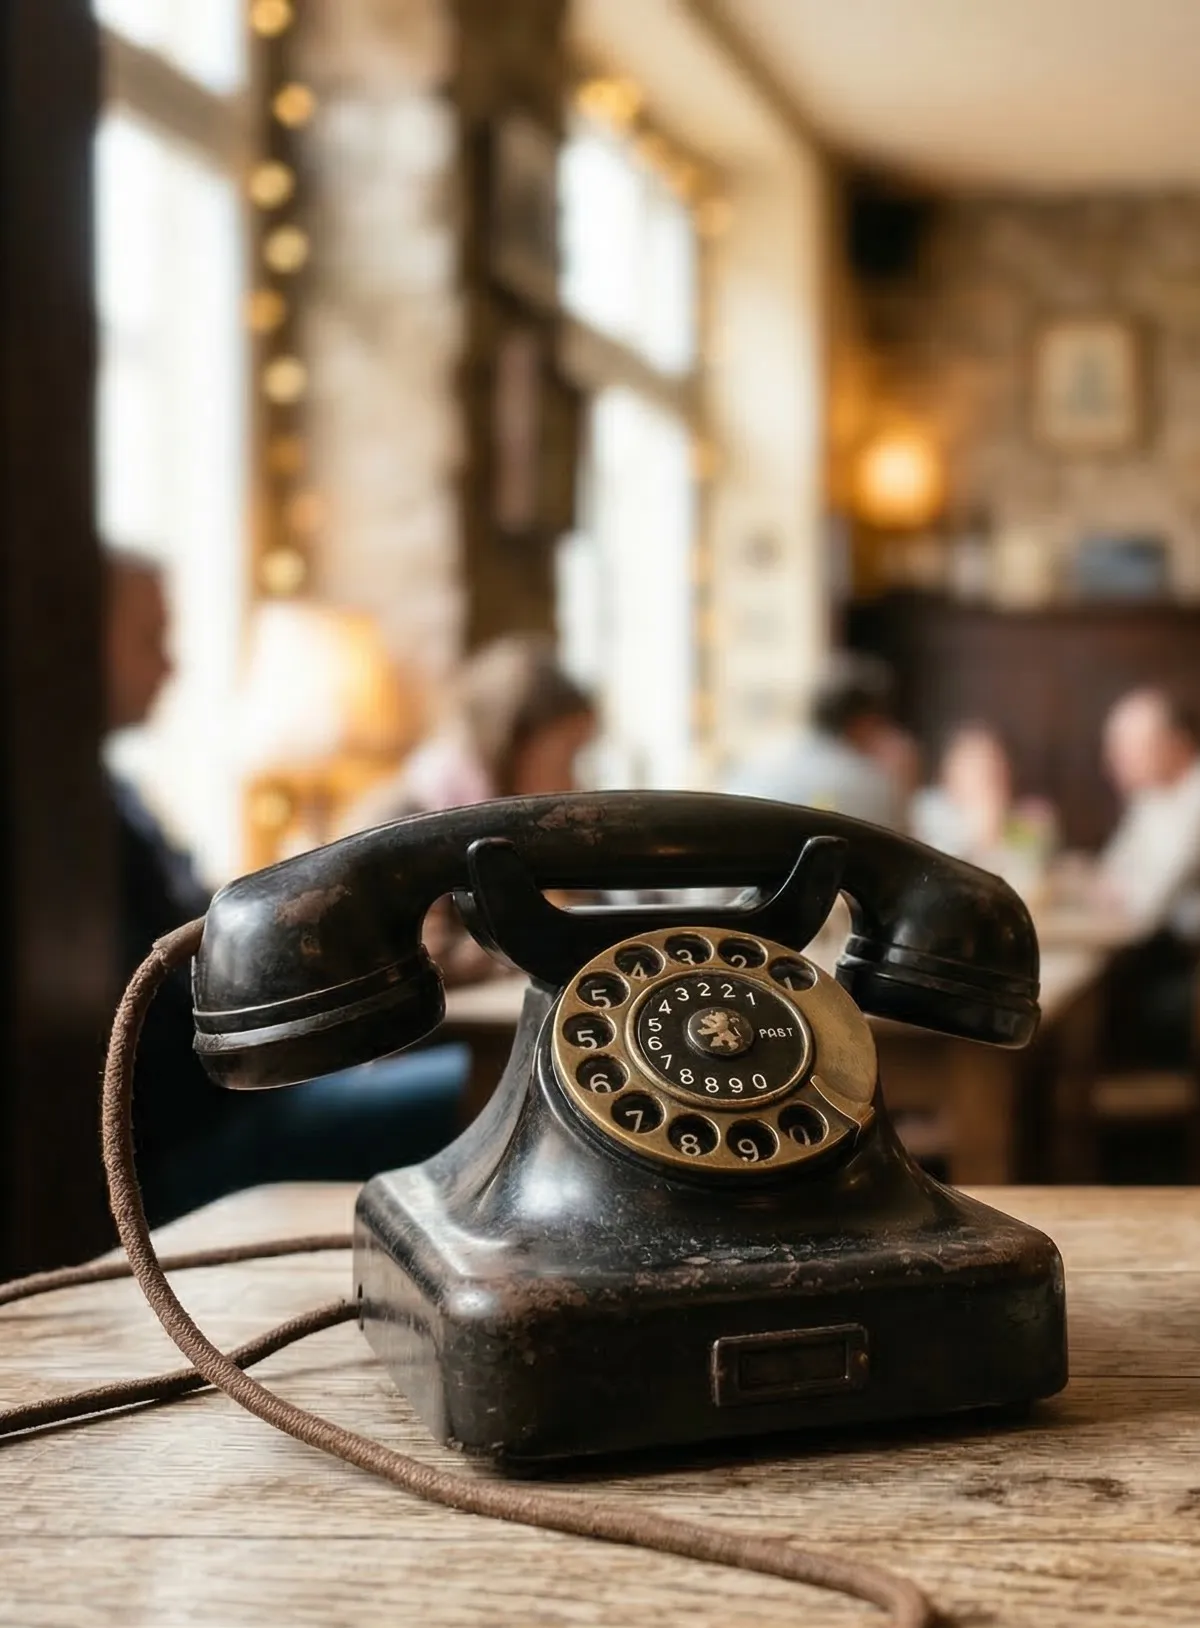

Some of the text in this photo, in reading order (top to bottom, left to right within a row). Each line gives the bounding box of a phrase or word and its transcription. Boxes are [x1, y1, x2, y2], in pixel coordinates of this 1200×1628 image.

[676, 949, 696, 966] 3
[631, 961, 648, 982] 4
[591, 989, 612, 1009] 5
[577, 1029, 598, 1050] 5
[647, 982, 767, 1093] 1 2 2 3 4 5 6 7 8 8 9 0
[589, 1073, 612, 1093] 6
[625, 1109, 644, 1134] 7
[680, 1133, 701, 1156] 8
[737, 1138, 759, 1162] 9
